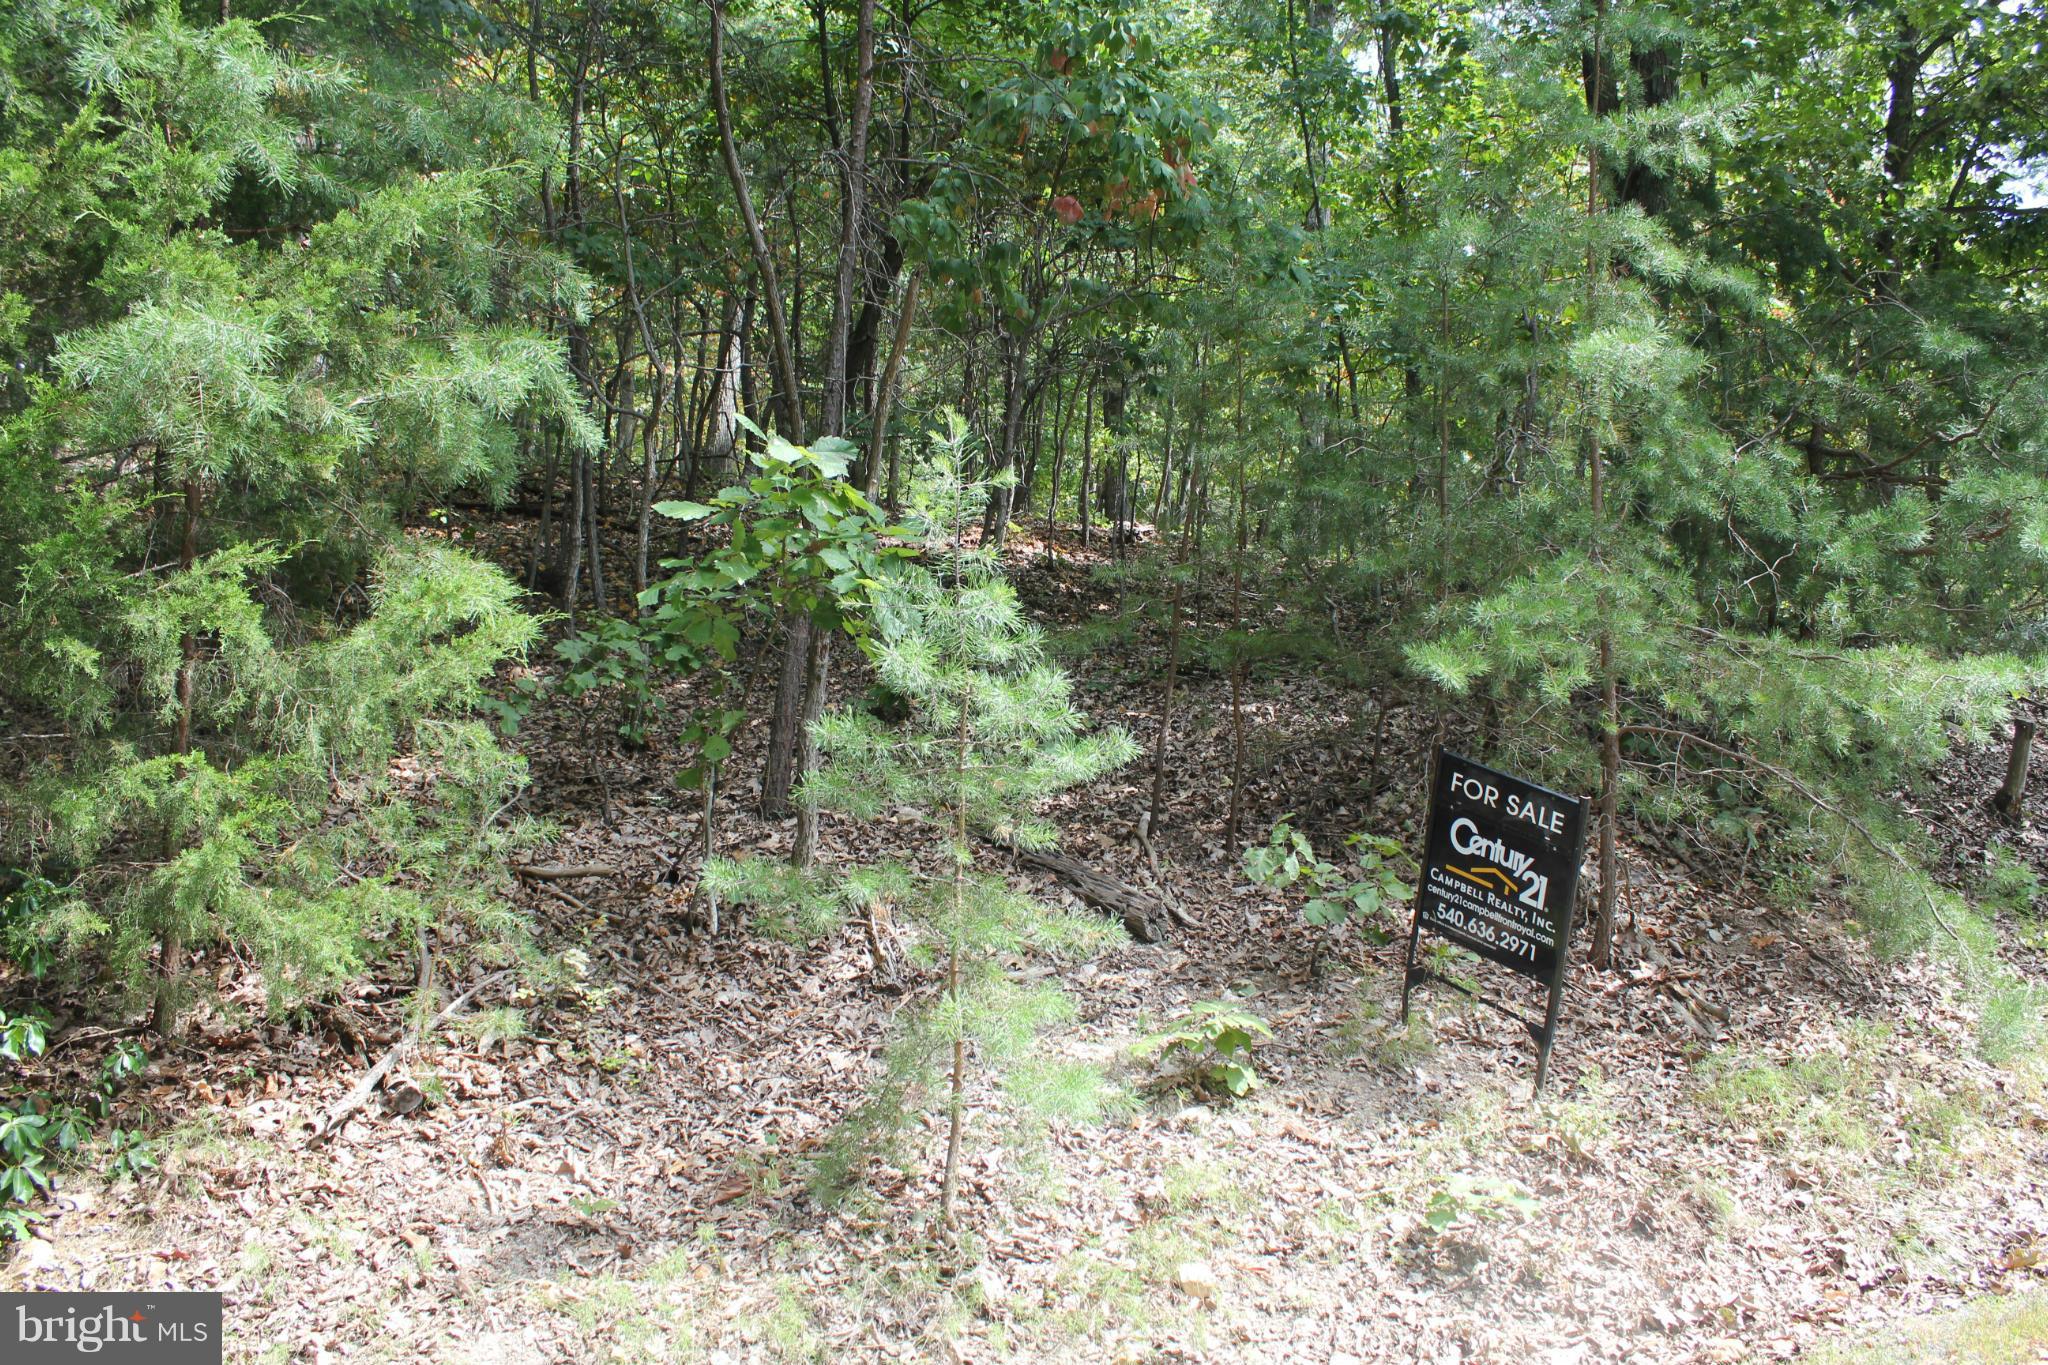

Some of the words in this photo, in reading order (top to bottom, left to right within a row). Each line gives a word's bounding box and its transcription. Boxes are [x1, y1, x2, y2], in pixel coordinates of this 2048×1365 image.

[1450, 772, 1499, 808] FOR
[1506, 795, 1565, 834] SALE
[1450, 817, 1534, 877] Century
[1430, 867, 1484, 901] CAMPBELL
[1487, 891, 1528, 923] REALTY,
[1532, 912, 1556, 933] INC.
[1518, 870, 1548, 911] 21
[1437, 902, 1536, 961] 540.636.2971
